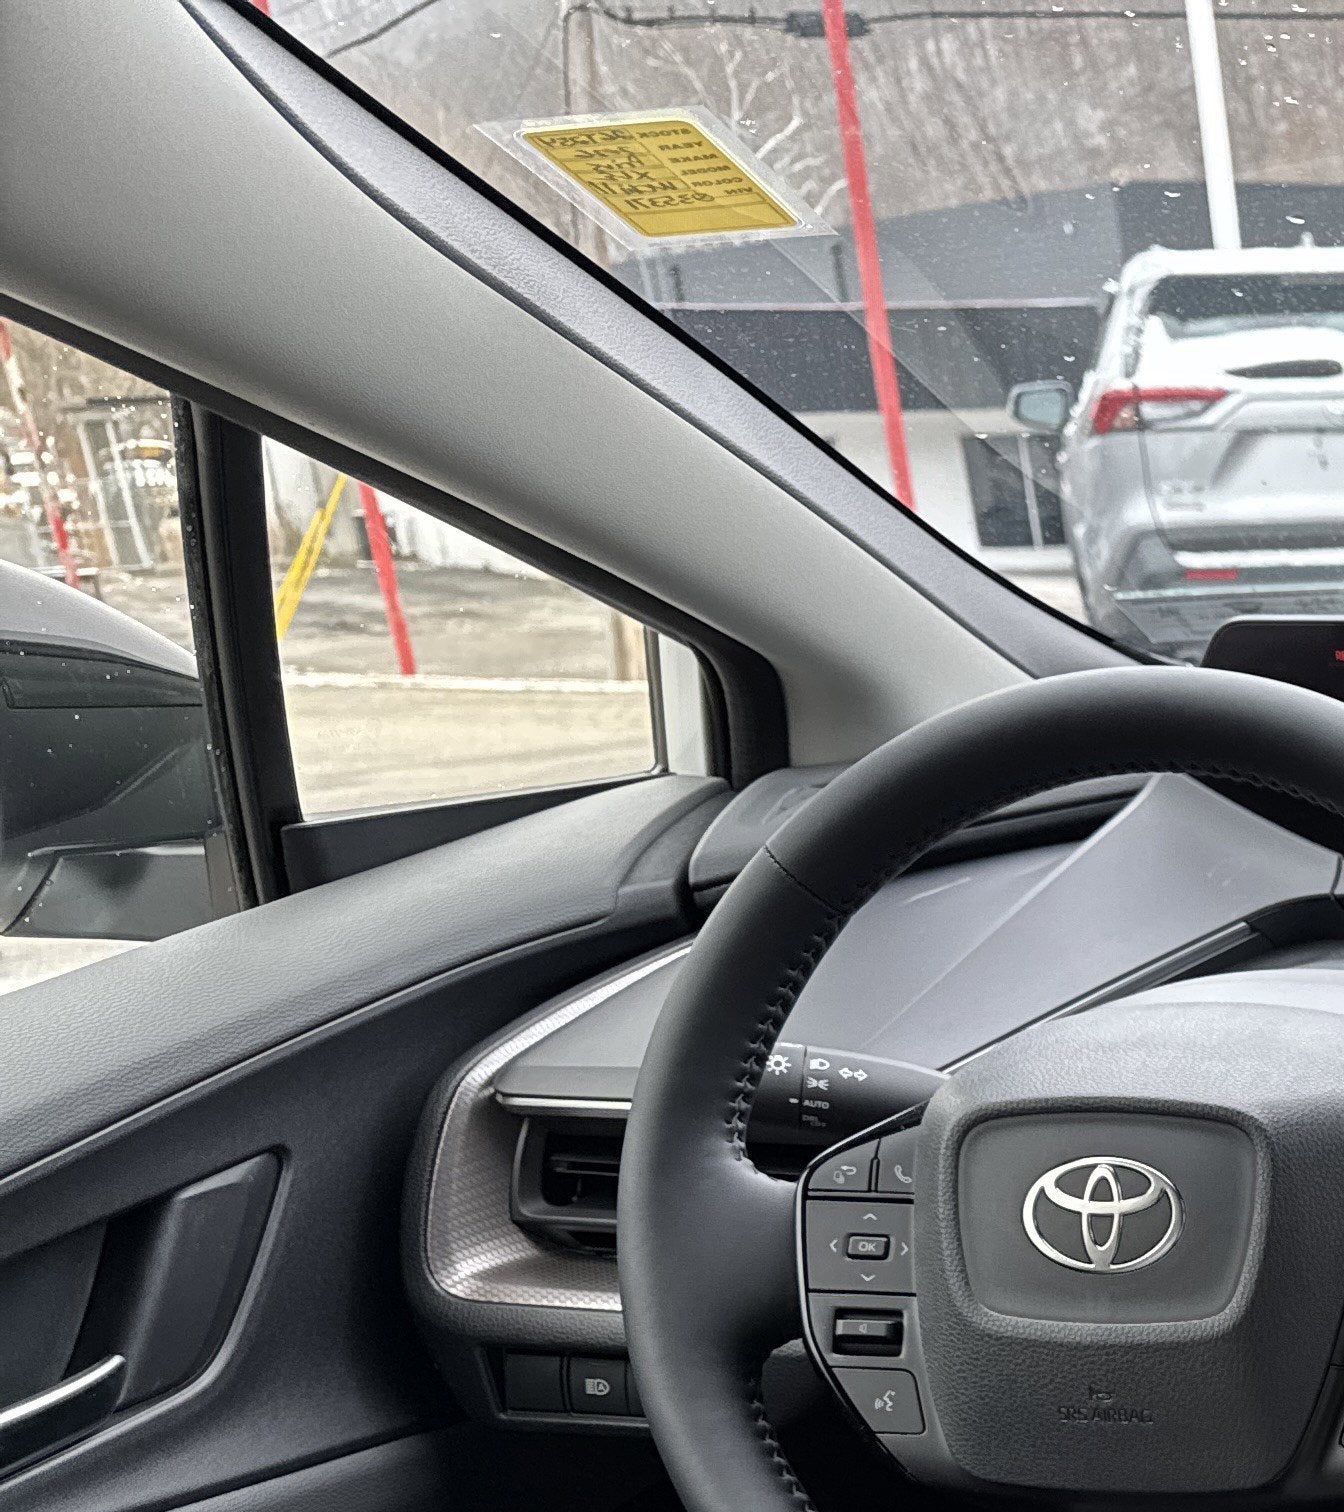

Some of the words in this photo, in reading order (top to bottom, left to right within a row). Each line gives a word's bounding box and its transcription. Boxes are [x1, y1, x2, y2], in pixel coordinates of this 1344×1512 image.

[803, 1099, 830, 1110] AUTO
[858, 1241, 876, 1252] OK
[1057, 1406, 1089, 1424] SRS
[1090, 1407, 1153, 1425] AIRBAG
